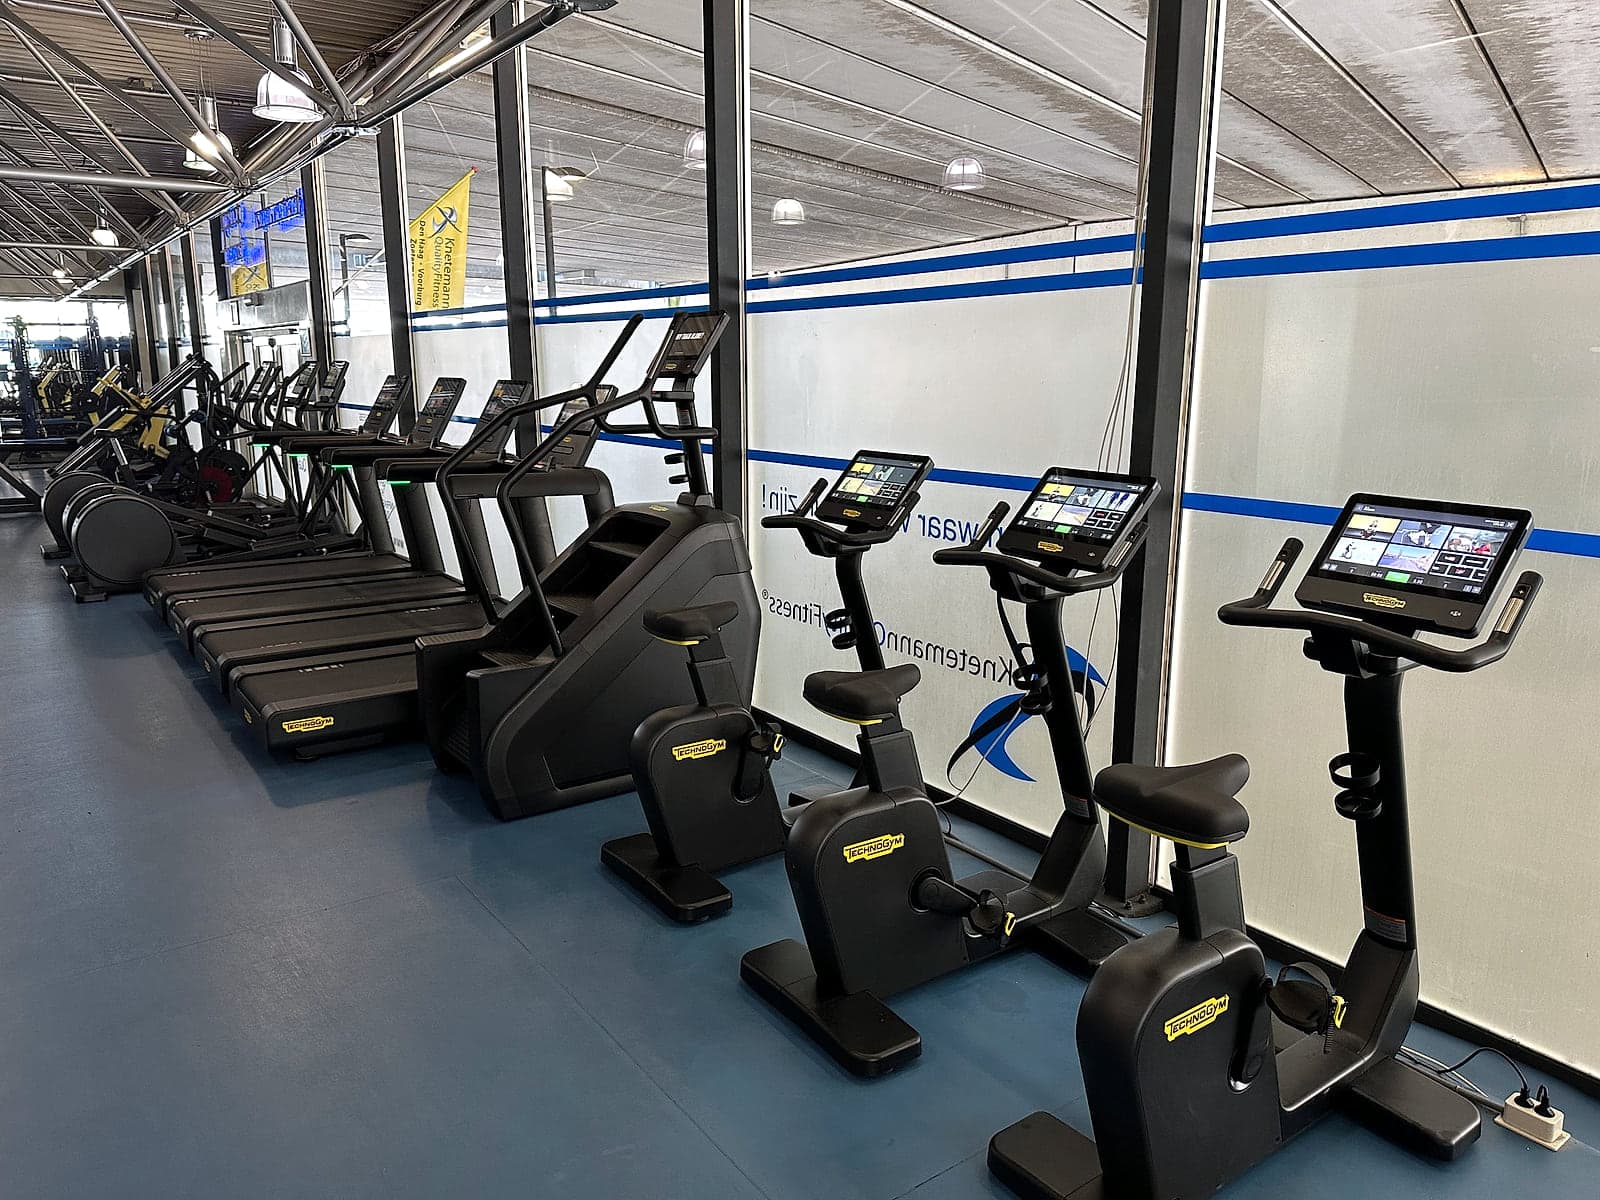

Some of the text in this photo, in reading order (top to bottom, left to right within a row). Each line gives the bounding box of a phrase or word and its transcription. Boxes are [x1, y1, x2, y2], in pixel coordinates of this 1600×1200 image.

[416, 238, 425, 259] Haag
[415, 268, 425, 306] Voorburg
[432, 236, 444, 308] QualityFitness
[442, 237, 455, 309] Knetemann
[844, 835, 904, 862] TECHNOGYM
[1166, 997, 1227, 1037] TECHNOGYM
